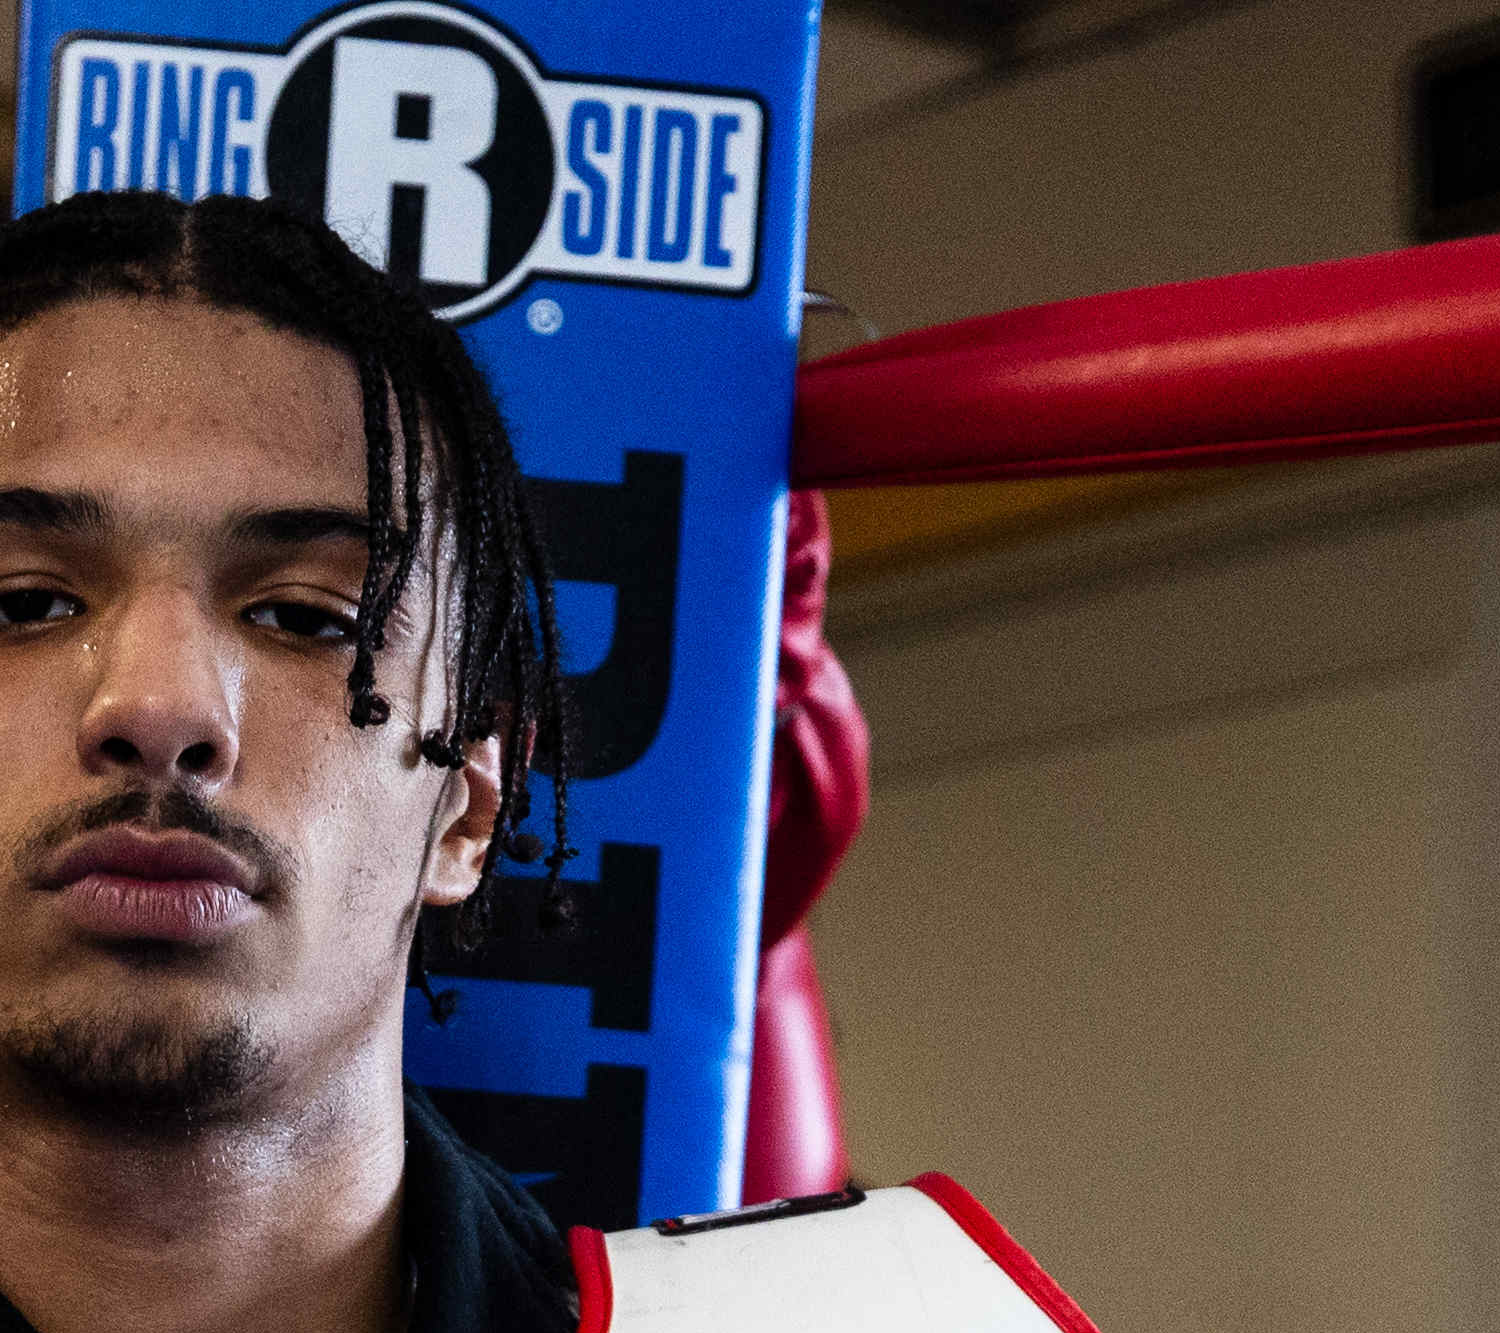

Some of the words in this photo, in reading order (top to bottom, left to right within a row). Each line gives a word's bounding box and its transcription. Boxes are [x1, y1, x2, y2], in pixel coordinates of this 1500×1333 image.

[76, 56, 257, 200] RING
[323, 36, 499, 287] R
[562, 97, 740, 269] SIDE
